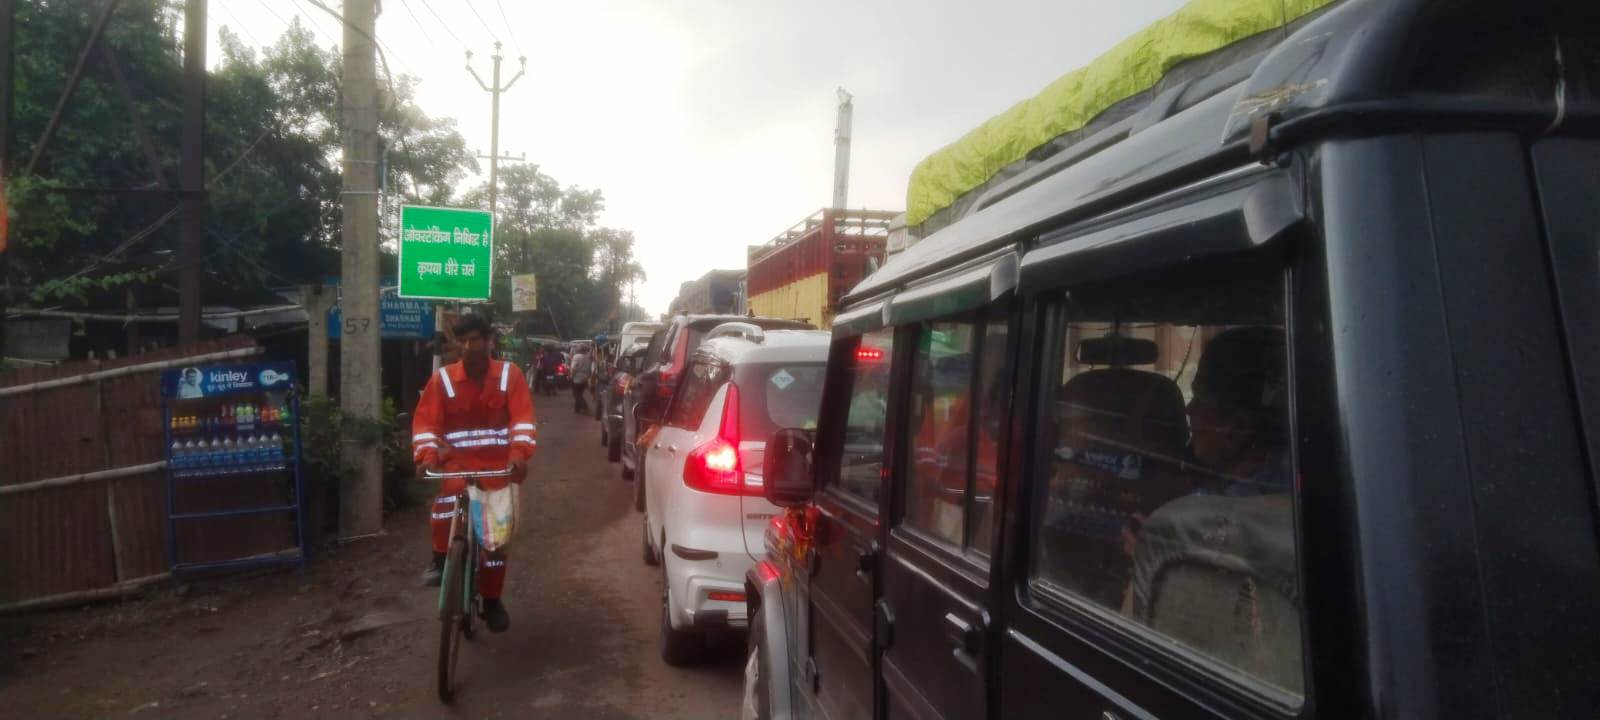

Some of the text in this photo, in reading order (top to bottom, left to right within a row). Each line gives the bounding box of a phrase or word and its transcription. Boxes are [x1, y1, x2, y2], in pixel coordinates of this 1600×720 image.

[482, 228, 489, 247] है
[417, 261, 442, 280] कृपया
[445, 257, 459, 276] धीरे
